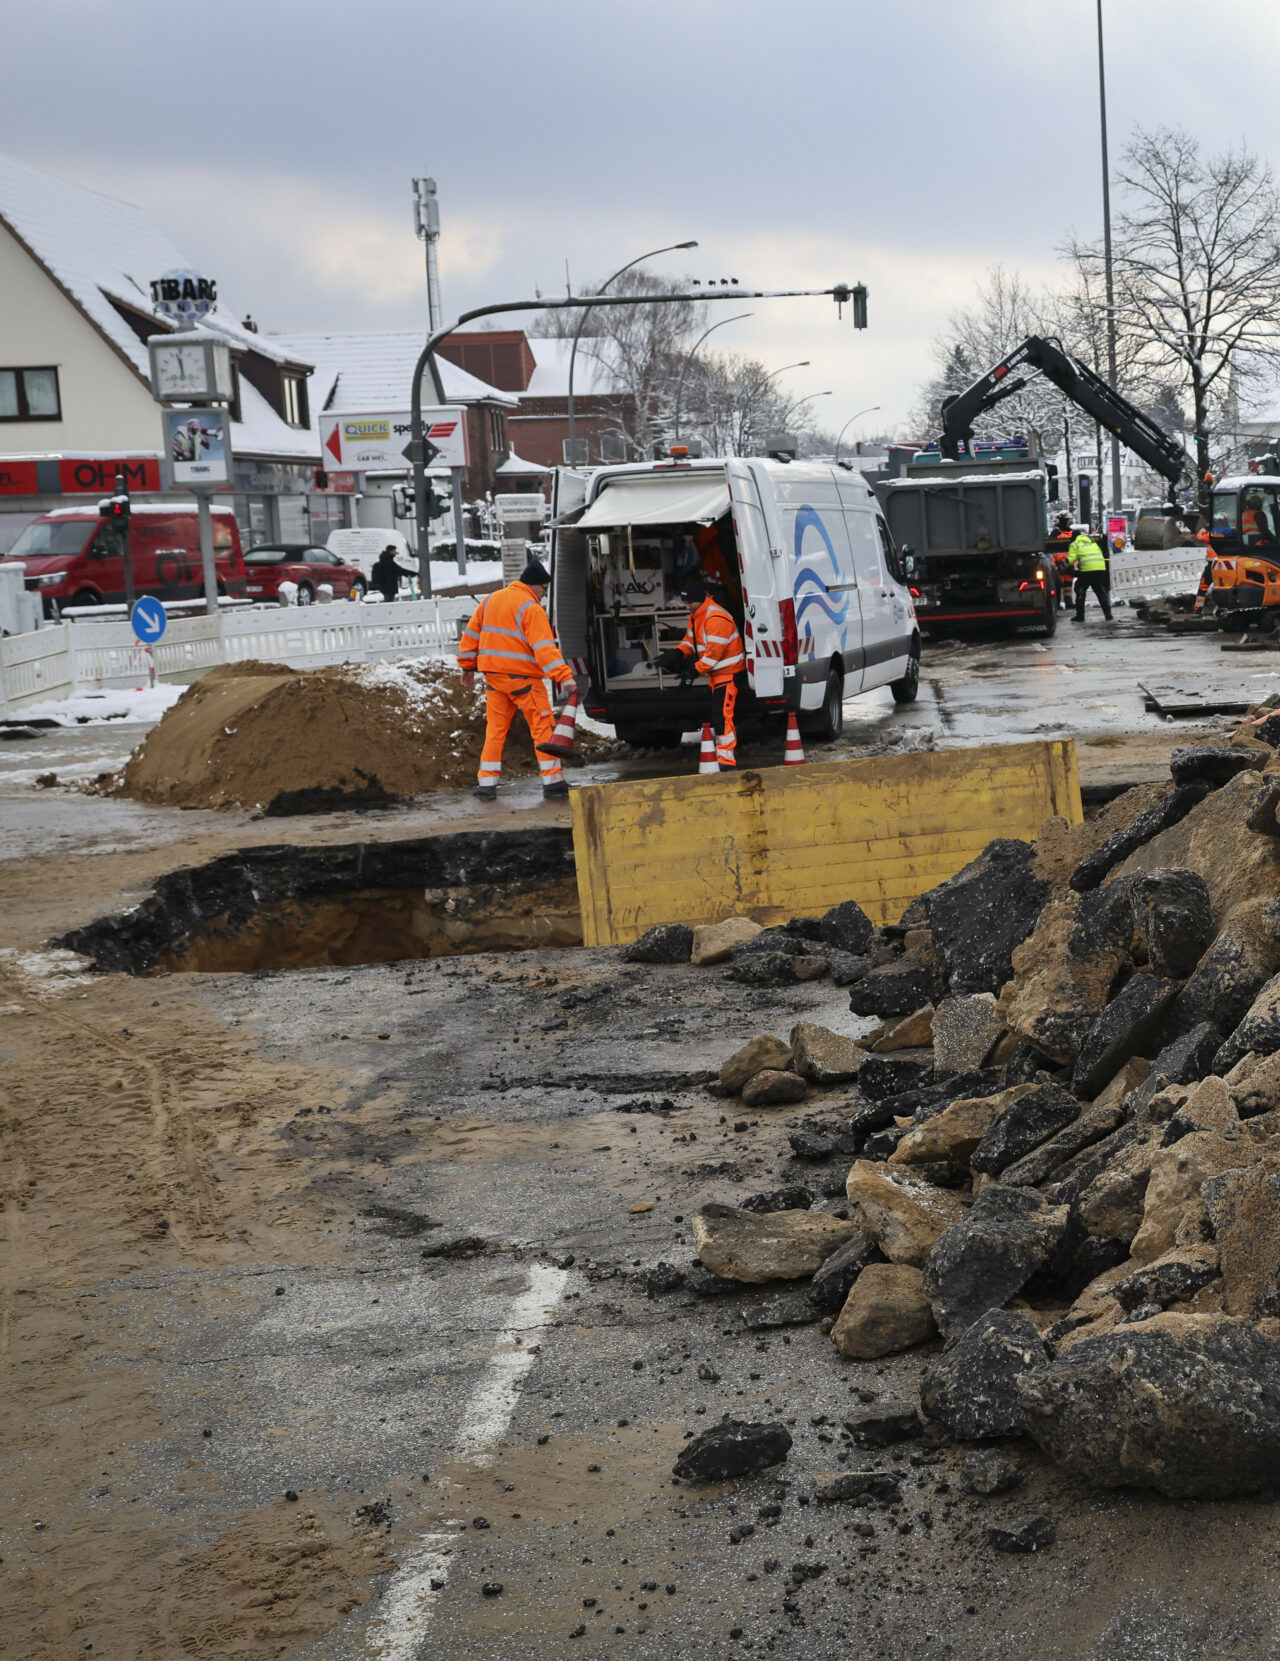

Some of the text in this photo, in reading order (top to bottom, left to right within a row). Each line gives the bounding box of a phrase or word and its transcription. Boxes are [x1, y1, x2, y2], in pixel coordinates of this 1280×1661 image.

[345, 423, 387, 435] QUICK
[74, 463, 147, 487] OHM
[1016, 624, 1049, 632] SCANIA
